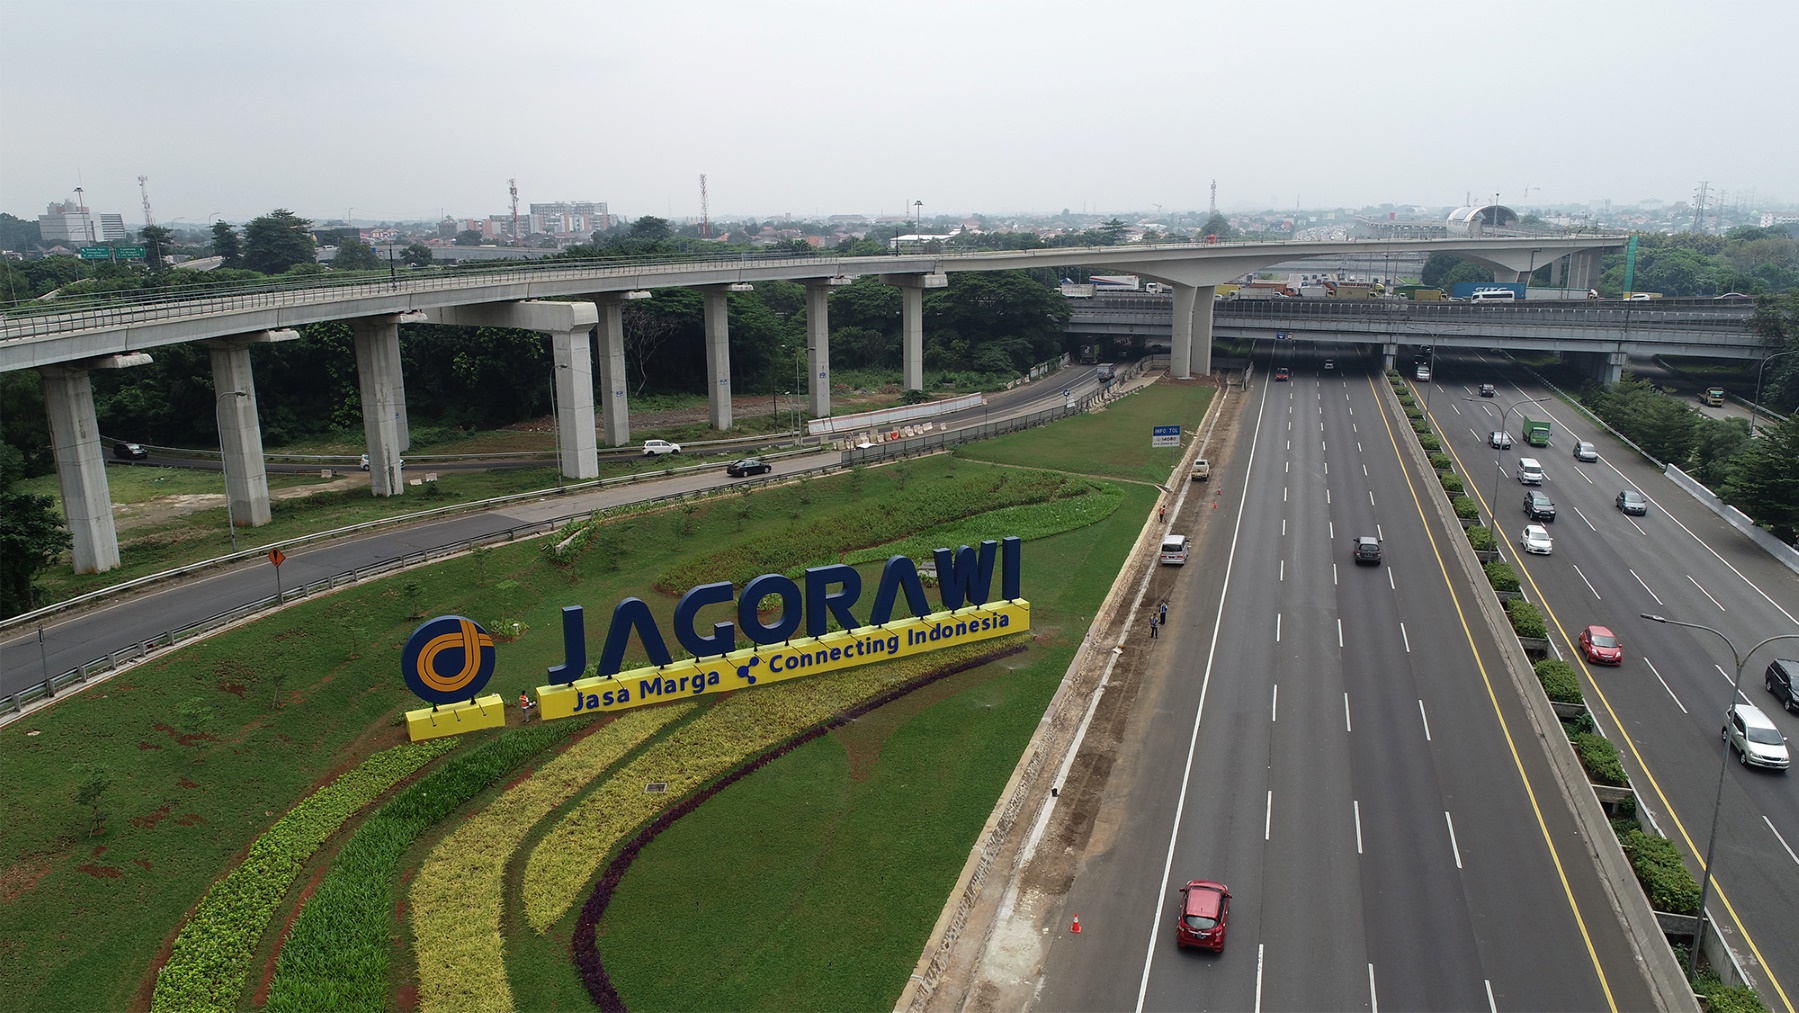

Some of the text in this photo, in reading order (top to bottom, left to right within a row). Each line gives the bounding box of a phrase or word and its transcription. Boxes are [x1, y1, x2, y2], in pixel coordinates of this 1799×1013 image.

[547, 536, 1021, 685] JAGORAWI
[573, 612, 1010, 712] Jasa Marga Connecting Indonesia
